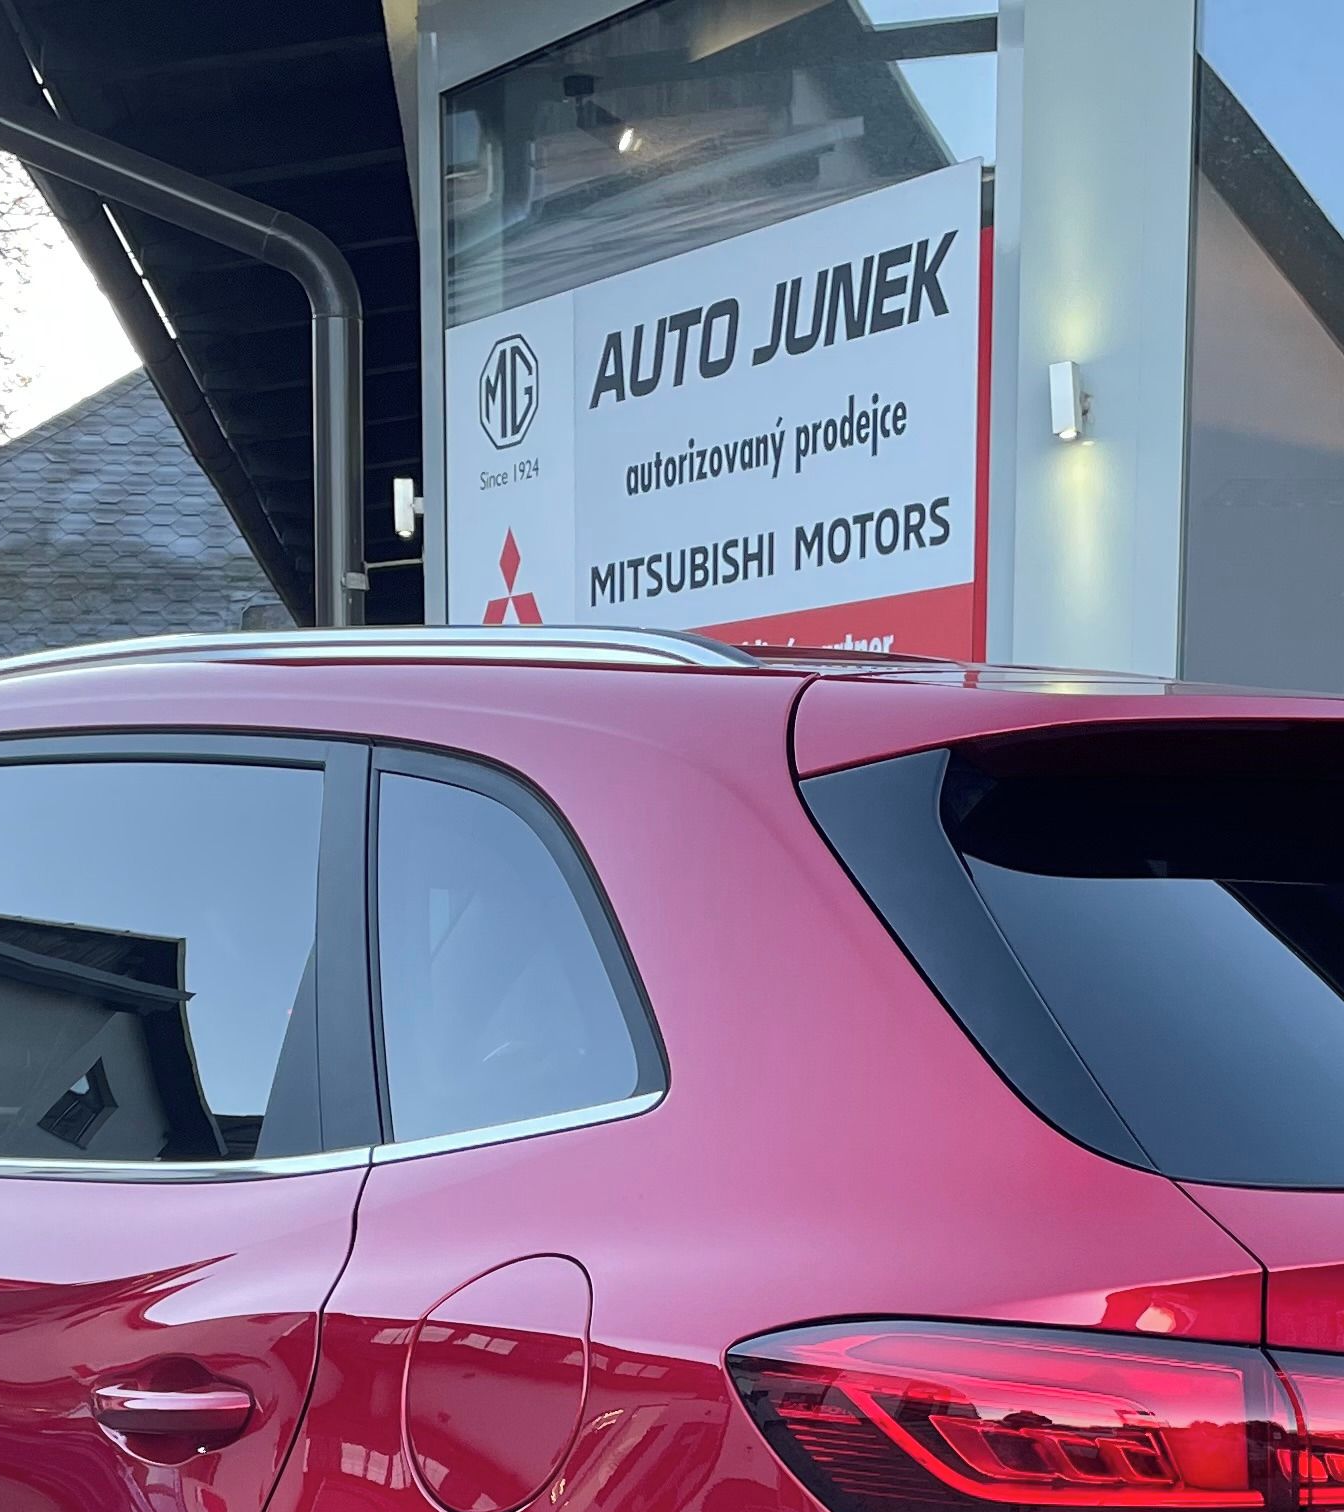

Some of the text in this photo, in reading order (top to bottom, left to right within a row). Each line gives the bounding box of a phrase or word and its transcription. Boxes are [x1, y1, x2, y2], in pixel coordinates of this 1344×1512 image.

[589, 230, 958, 409] AUTO JUNEK
[483, 341, 536, 444] MG
[479, 457, 540, 492] Since 1924
[626, 393, 907, 496] autorizovaný prodejce
[590, 496, 950, 607] MITSUBISHI MOTORS
